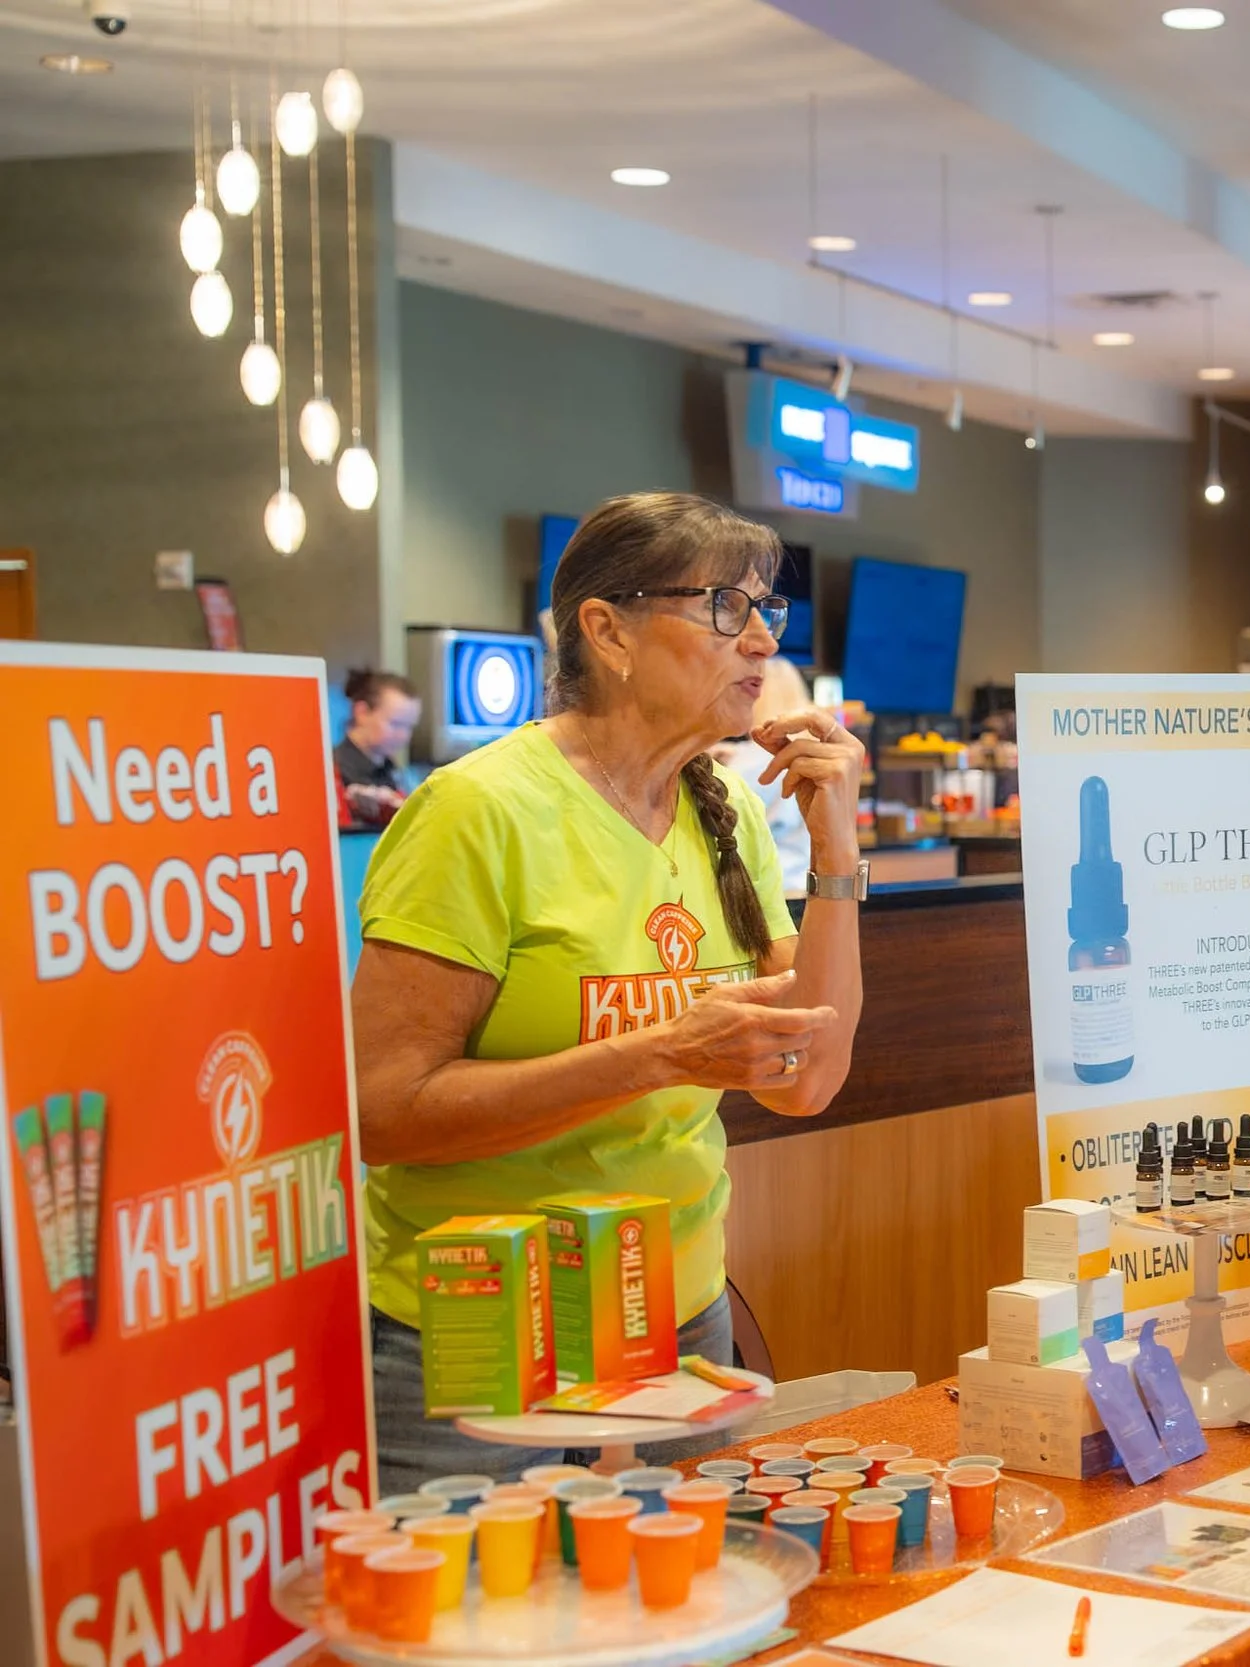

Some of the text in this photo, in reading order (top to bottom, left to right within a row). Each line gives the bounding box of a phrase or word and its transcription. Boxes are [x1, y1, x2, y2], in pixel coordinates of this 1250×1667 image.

[1053, 708, 1147, 736] MOTHER
[48, 712, 280, 826] Need a
[1144, 831, 1207, 866] GLP
[28, 849, 309, 982] BOOST?
[1149, 964, 1187, 979] THREE's
[1188, 964, 1207, 975] new
[1210, 958, 1250, 979] patented
[1149, 981, 1194, 998] Metabolic
[1196, 981, 1223, 995] Boost
[1183, 998, 1220, 1014] THREE's
[1202, 1018, 1212, 1031] to
[1214, 1015, 1230, 1030] the
[116, 1144, 346, 1330] KYNETIK
[1144, 1241, 1188, 1279] LEAN
[135, 1348, 300, 1521] FREE
